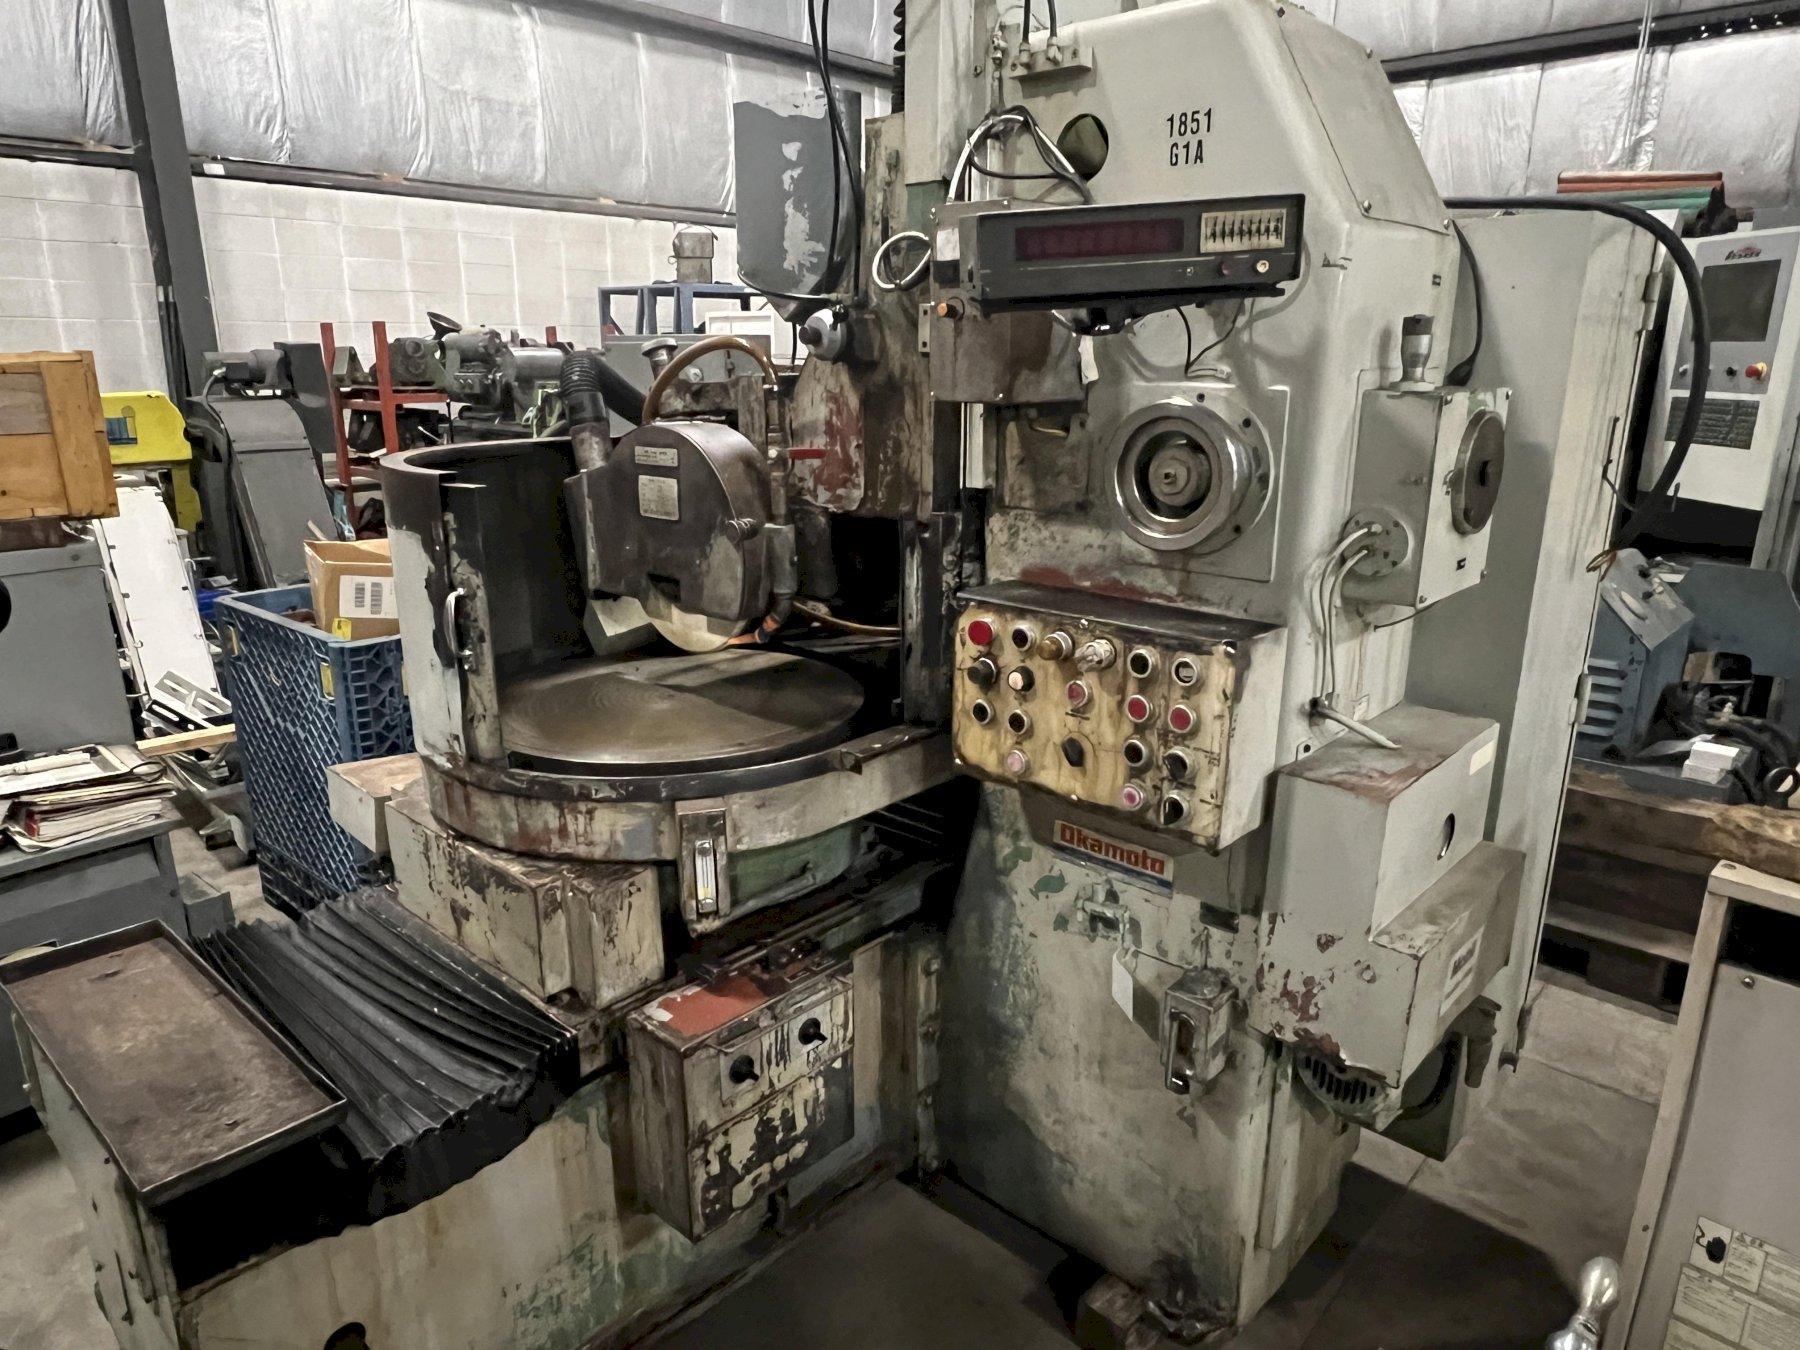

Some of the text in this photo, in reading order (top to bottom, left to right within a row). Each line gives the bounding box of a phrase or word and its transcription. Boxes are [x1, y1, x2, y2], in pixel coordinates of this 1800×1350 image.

[1166, 107, 1212, 138] 1851
[1169, 139, 1204, 166] G1A
[1060, 822, 1165, 876] Okamoto
